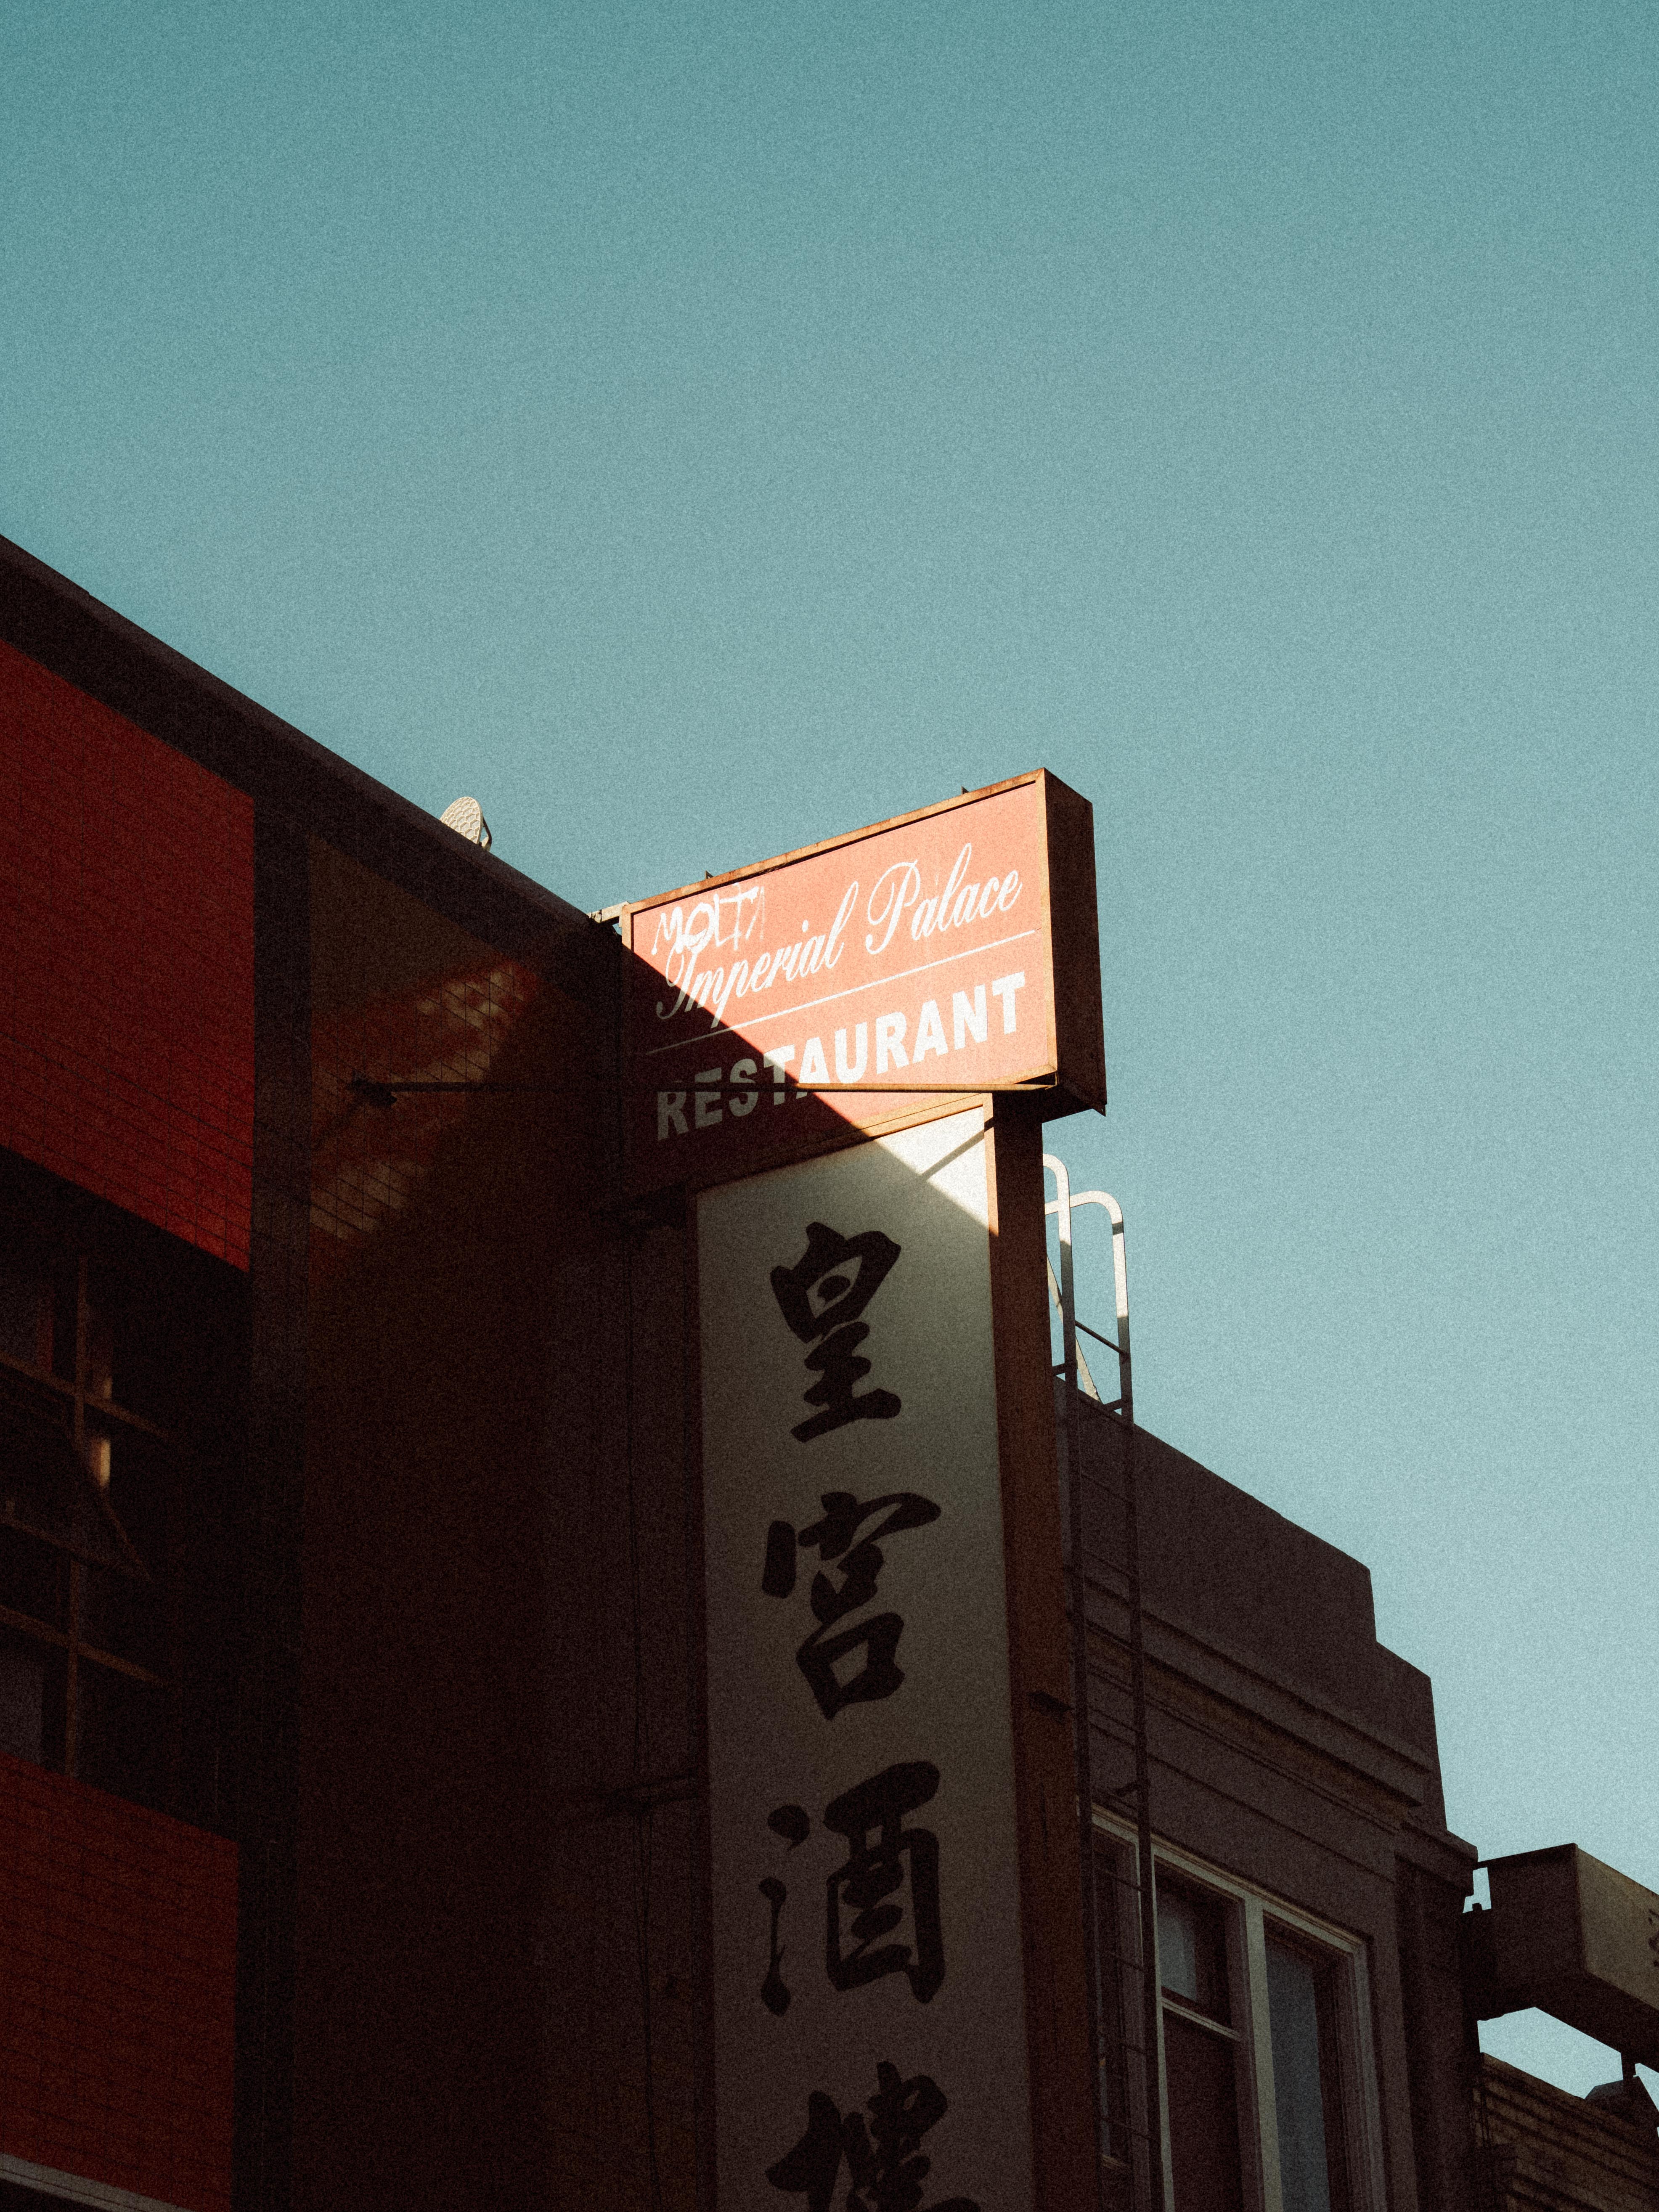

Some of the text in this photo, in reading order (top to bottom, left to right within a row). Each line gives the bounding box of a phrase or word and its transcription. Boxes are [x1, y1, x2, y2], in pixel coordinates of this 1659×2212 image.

[656, 842, 1023, 1029] Imperial Palace
[657, 971, 1026, 1142] RESTAURANT
